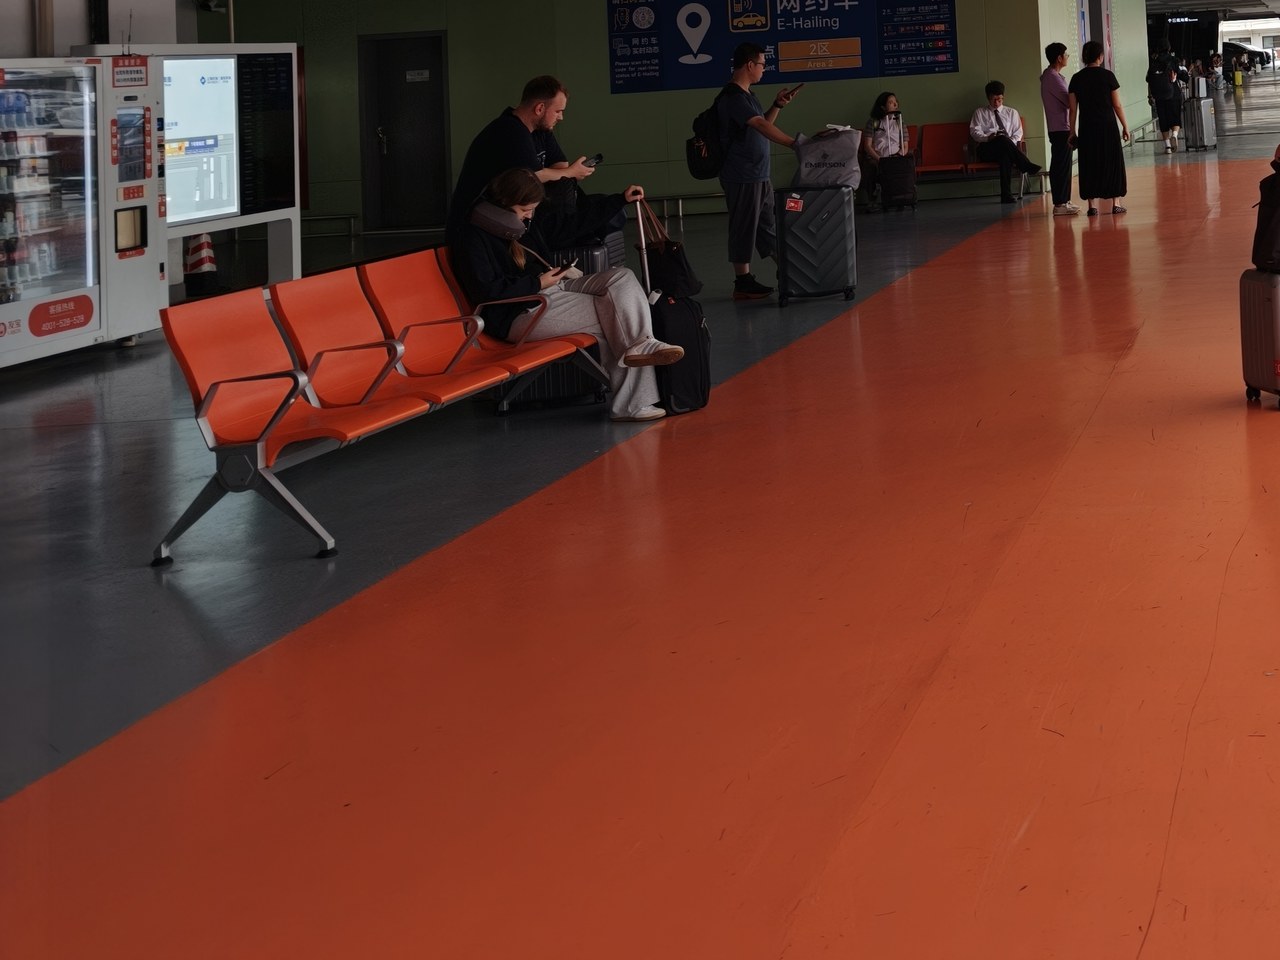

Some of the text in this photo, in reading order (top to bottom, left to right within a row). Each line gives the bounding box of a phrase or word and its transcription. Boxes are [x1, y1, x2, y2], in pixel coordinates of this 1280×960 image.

[777, 16, 840, 30] E-Hailing
[809, 41, 831, 56] 2区
[807, 61, 826, 69] Area
[804, 161, 847, 169] EMERSON
